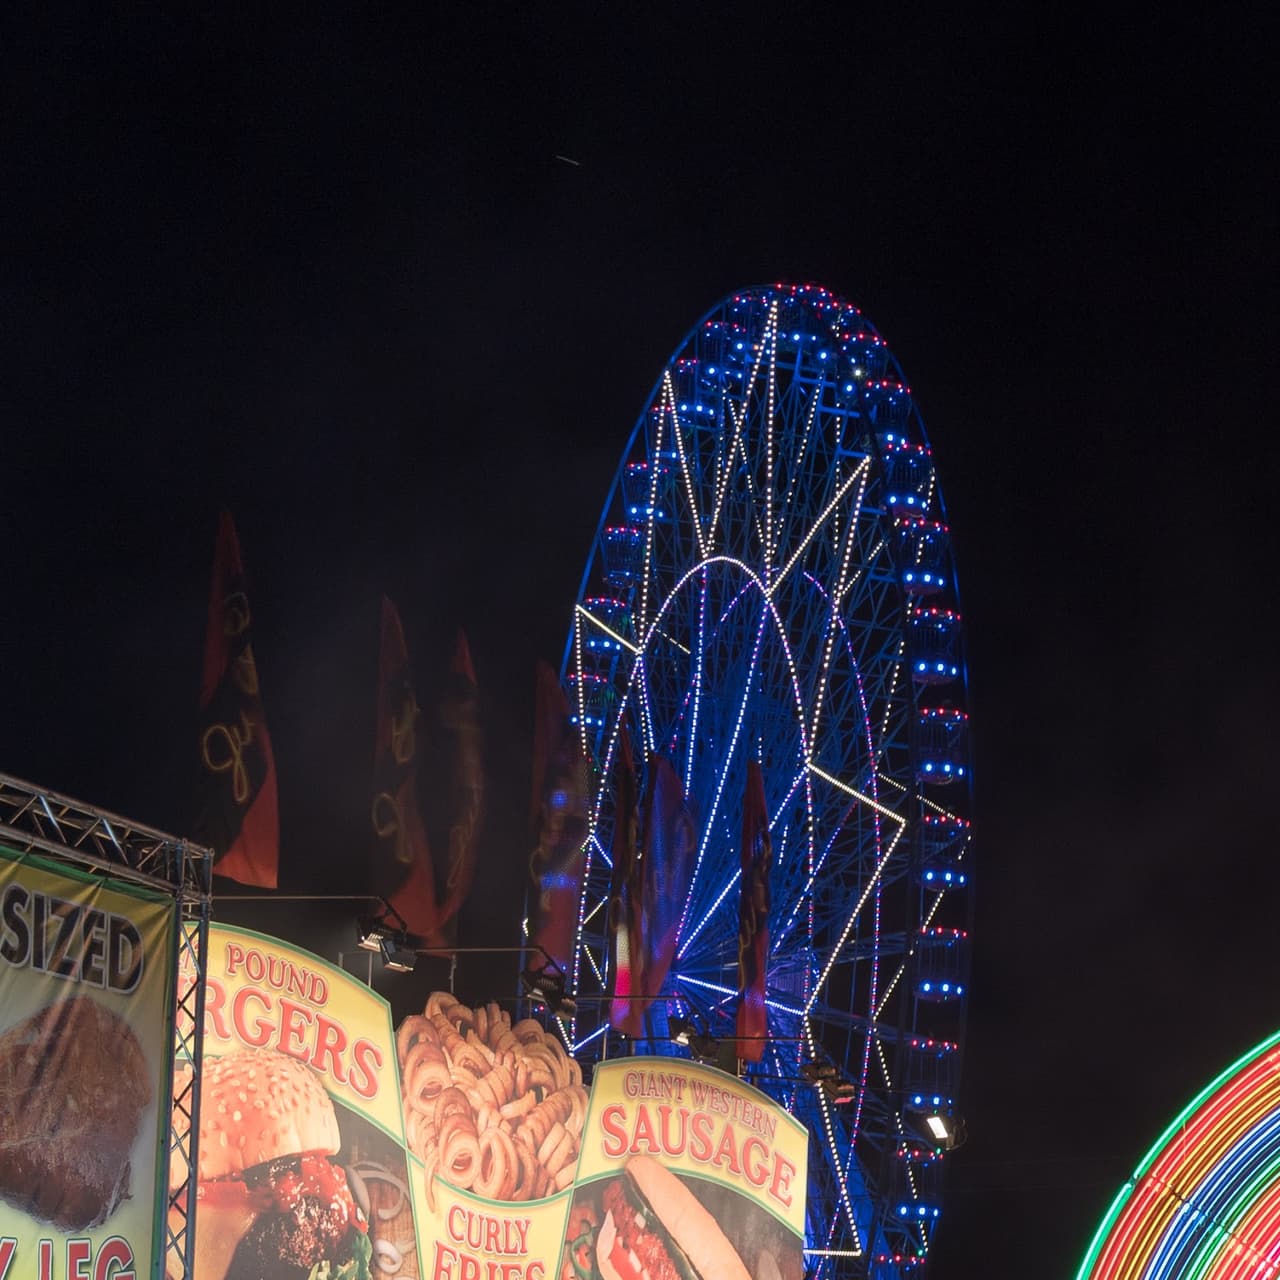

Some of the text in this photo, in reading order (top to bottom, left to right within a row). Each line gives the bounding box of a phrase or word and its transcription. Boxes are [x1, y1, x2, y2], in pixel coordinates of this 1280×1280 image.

[0, 883, 144, 995] SIZED
[226, 942, 329, 1006] POUND
[624, 1070, 777, 1138] GIANT WESTERN
[601, 1103, 797, 1208] SAUSAGE
[447, 1204, 532, 1255] CURLY
